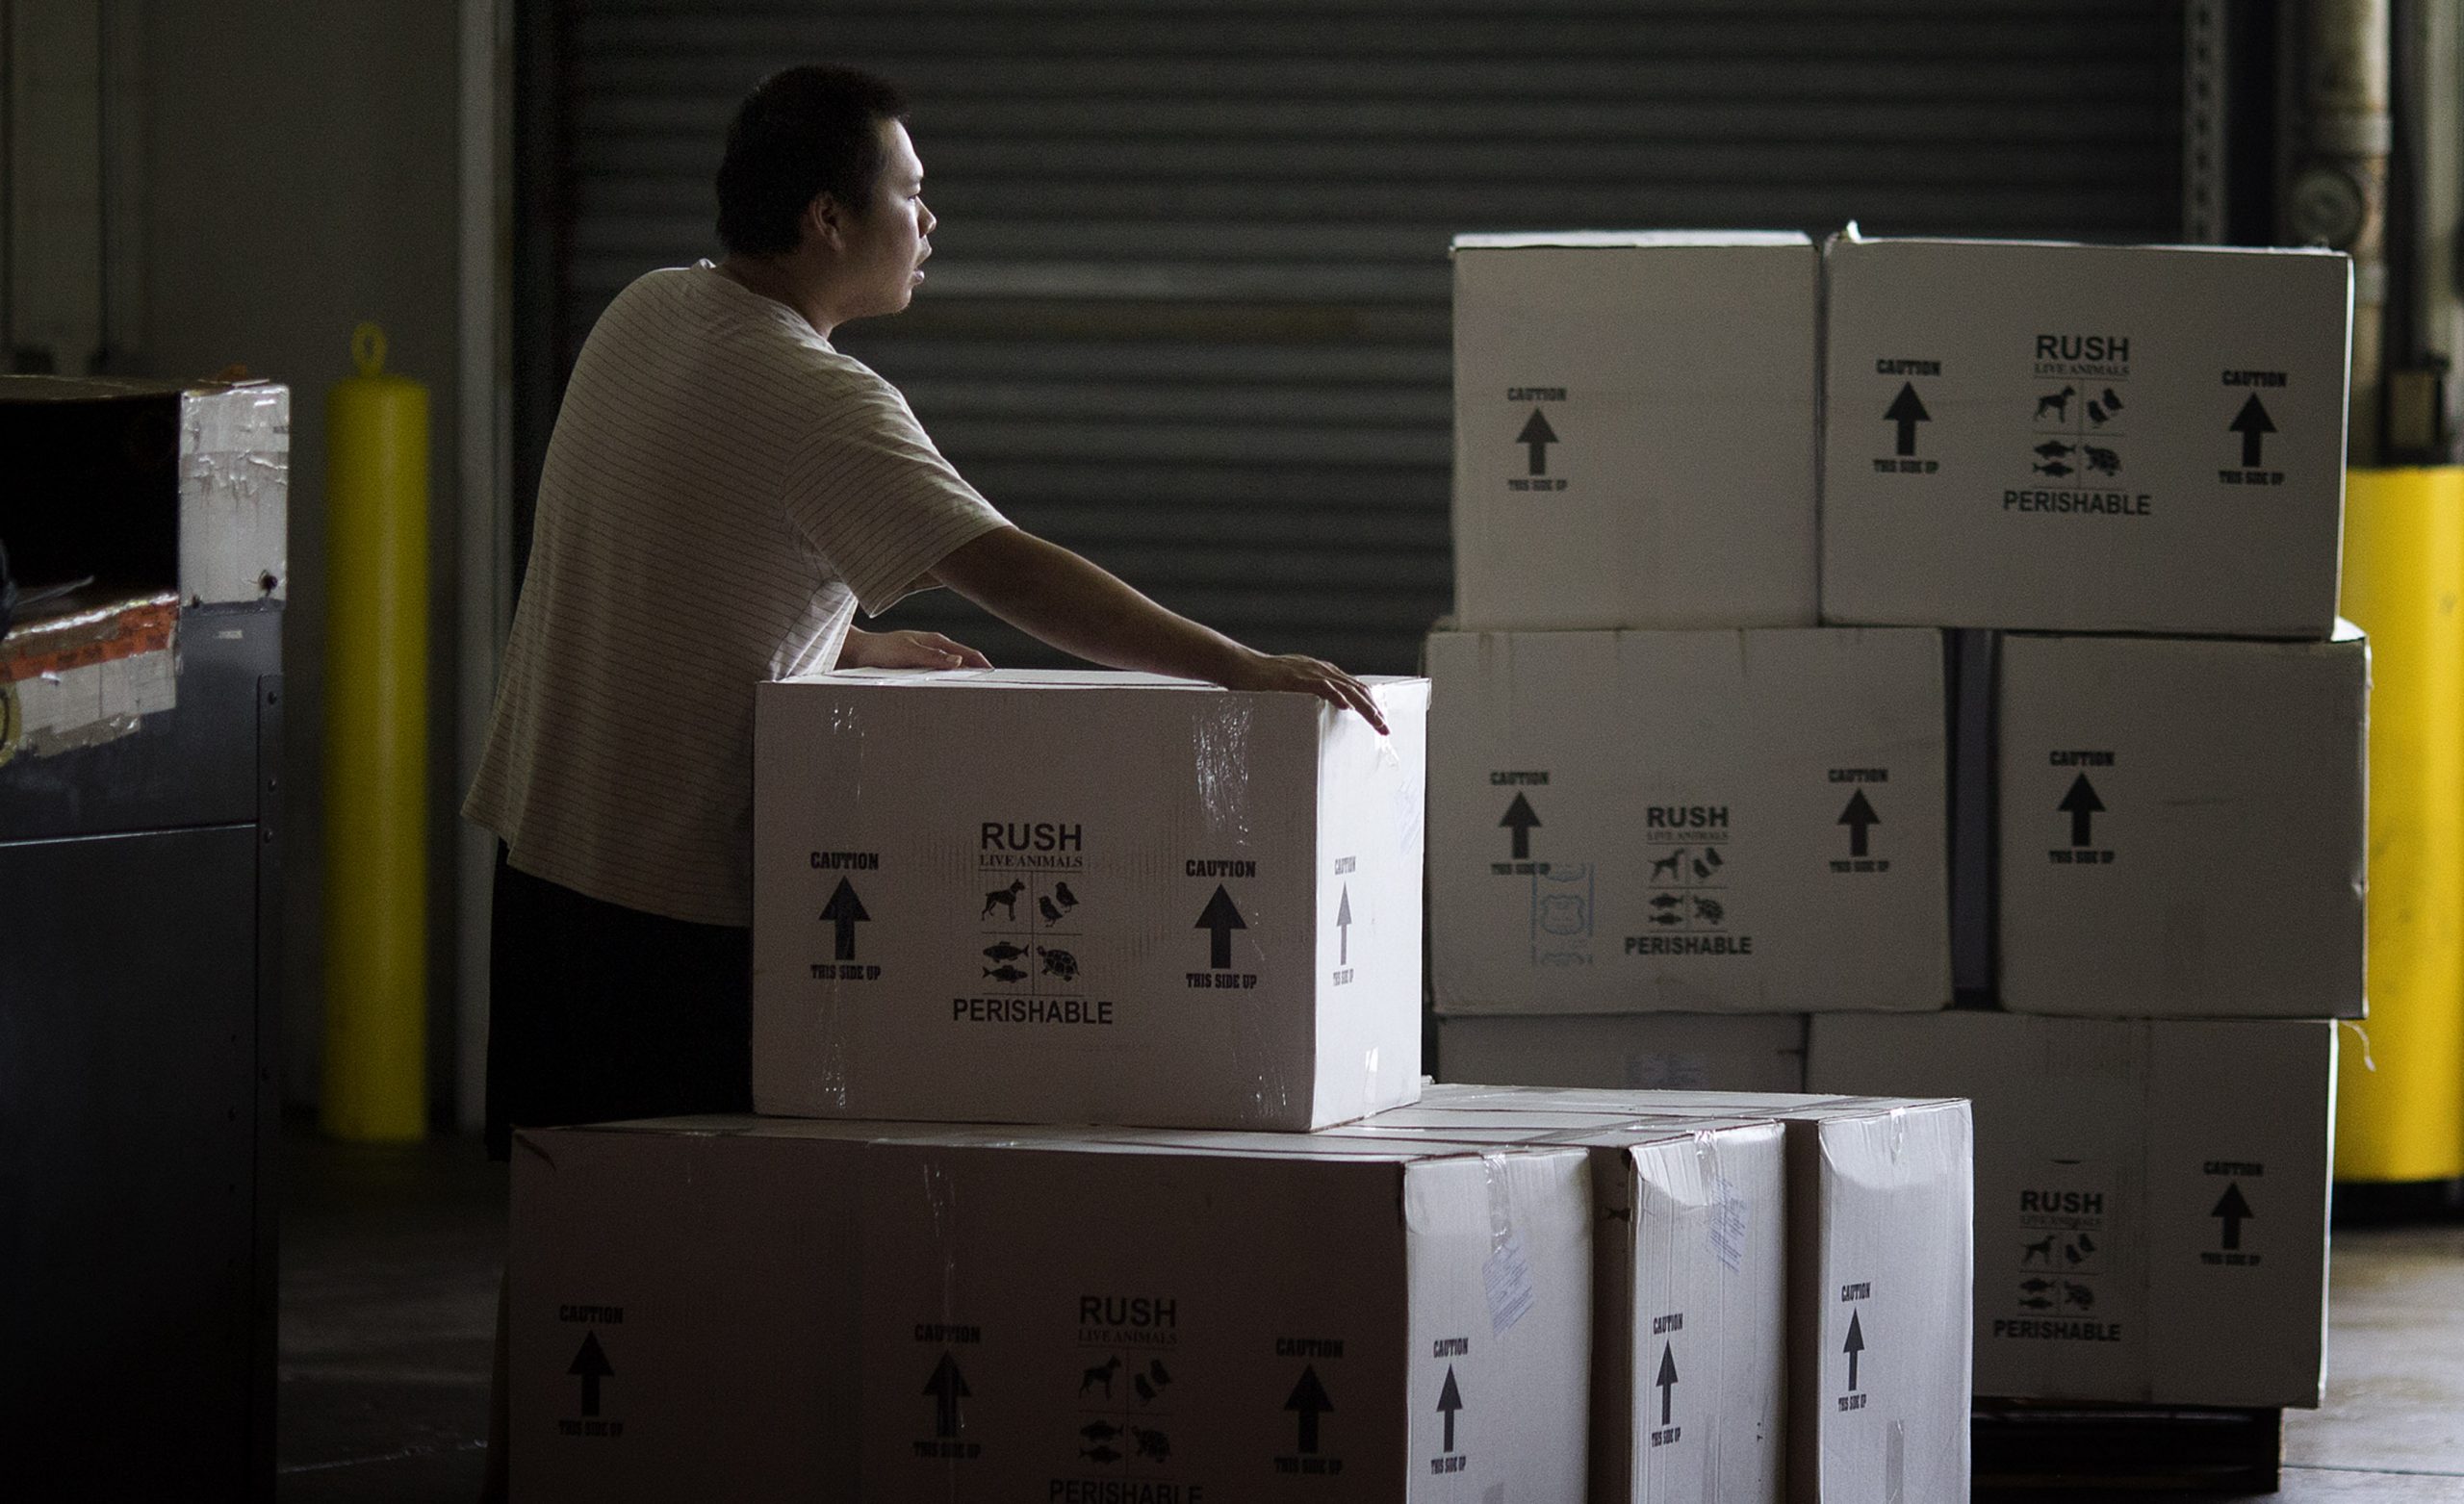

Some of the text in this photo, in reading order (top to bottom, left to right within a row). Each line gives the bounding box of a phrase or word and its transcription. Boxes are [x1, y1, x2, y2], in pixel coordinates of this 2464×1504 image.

[2036, 334, 2130, 362] RUSH
[1876, 359, 1941, 376] CAUTION
[2221, 370, 2288, 388] CAUTION
[1507, 387, 1567, 402] CAUTION
[2003, 490, 2152, 516] PERISHABLE
[2049, 751, 2116, 767] CAUTION
[1489, 771, 1550, 786] CAUTION
[1828, 768, 1888, 783] CAUTION
[1647, 805, 1730, 828] RUSH
[980, 822, 1082, 851] RUSH
[809, 851, 880, 871] CAUTION
[1185, 859, 1256, 878] CAUTION
[1334, 855, 1356, 876] CAUTION
[1625, 936, 1753, 956] PERISHABLE
[810, 964, 882, 981] THIS SIDE UP
[1185, 973, 1258, 989] THIS SIDE UP
[953, 999, 1114, 1024] PERISHABLE
[2203, 1161, 2265, 1177] CAUTION
[2020, 1189, 2103, 1214] RUSH
[1841, 1282, 1871, 1302] CAUTION
[559, 1304, 624, 1324] CAUTION
[1078, 1295, 1176, 1328] RUSH
[913, 1323, 981, 1343] CAUTION
[1653, 1313, 1683, 1335] CAUTION
[1993, 1319, 2121, 1342] PERISHABLE
[1275, 1338, 1345, 1358] CAUTION
[1433, 1338, 1469, 1358] CAUTION
[1430, 1456, 1467, 1475] THIS SIDE UP
[1049, 1479, 1203, 1504] PERISHABLE
